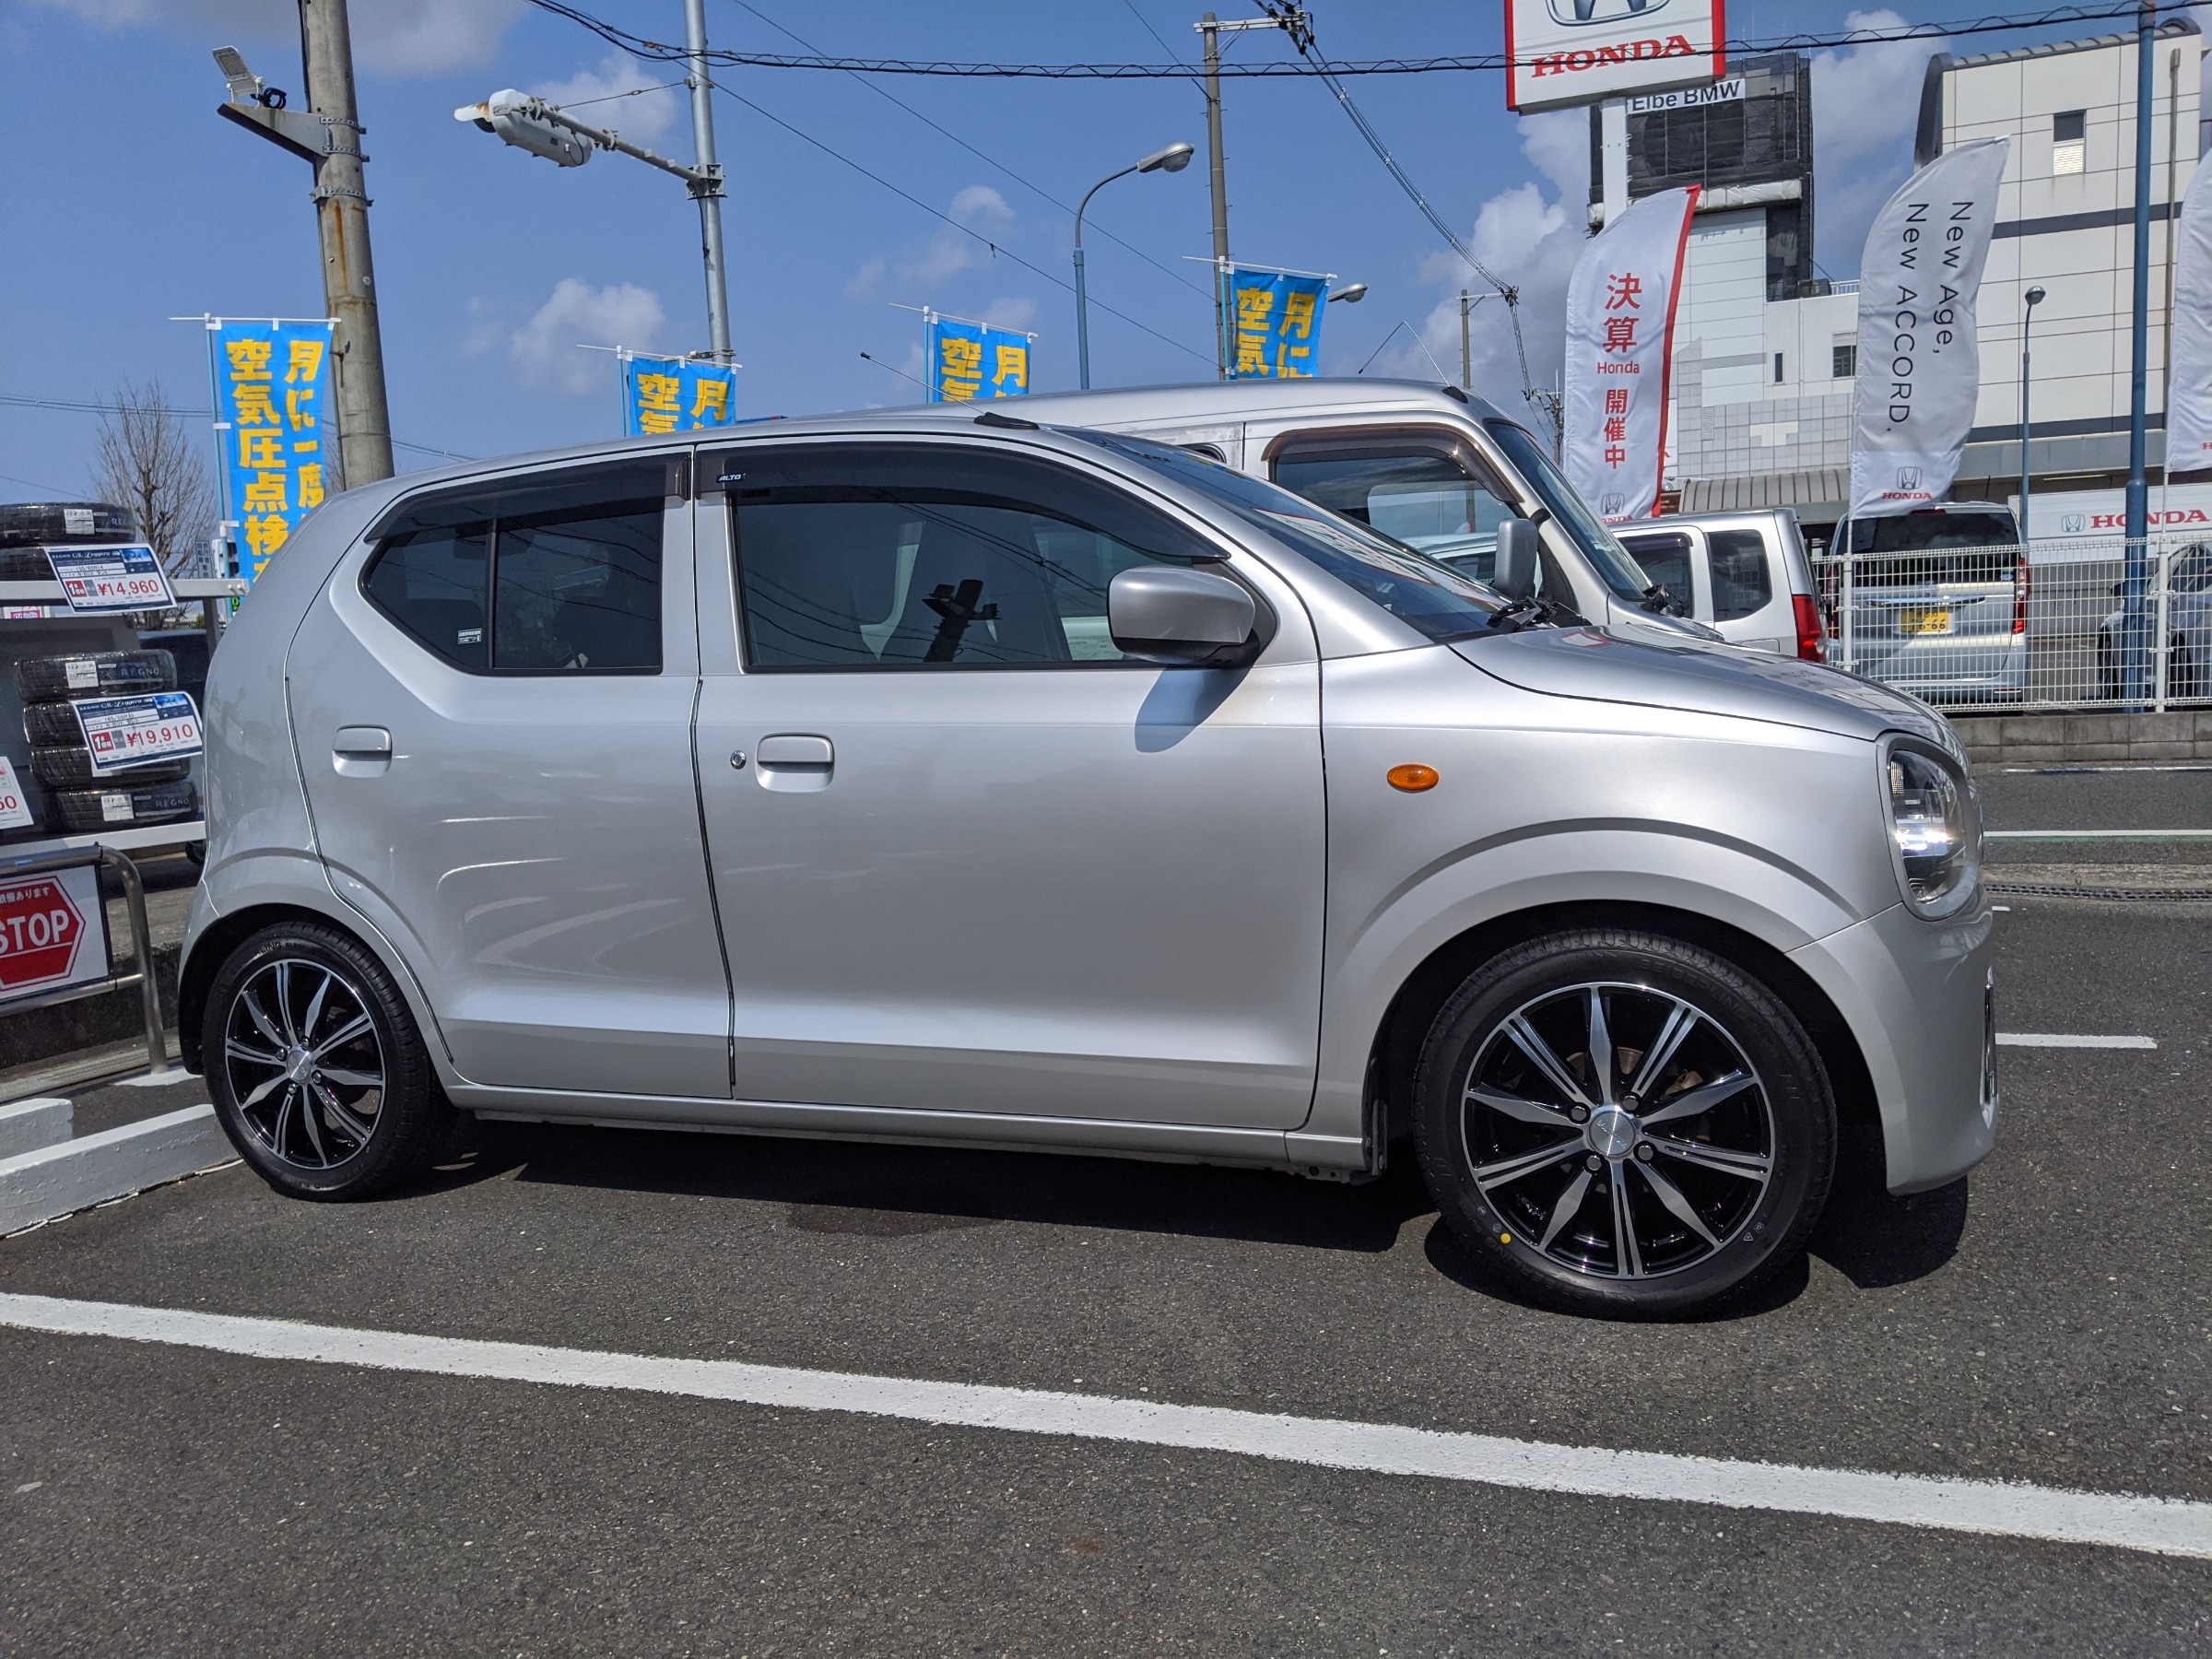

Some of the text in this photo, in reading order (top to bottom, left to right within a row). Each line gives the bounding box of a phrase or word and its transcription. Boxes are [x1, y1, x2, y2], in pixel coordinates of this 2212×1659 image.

[1531, 35, 1696, 77] HONDA
[1632, 80, 1740, 112] Elbe BMW
[1933, 201, 1974, 353] New Age,
[1236, 288, 1274, 376] 空気
[1602, 273, 1642, 353] 決算
[1887, 204, 1929, 431] New ACCORD.
[992, 345, 1028, 397] 月
[1597, 360, 1640, 374] Honda
[285, 340, 324, 518] 月に一度
[690, 379, 728, 429] 月
[1604, 389, 1629, 469] 開催中
[226, 339, 288, 582] 空気圧点検
[718, 474, 742, 482] ALTO
[98, 580, 159, 596] ¥14,960
[121, 668, 159, 677] REGNO
[126, 724, 194, 747] ¥19,910
